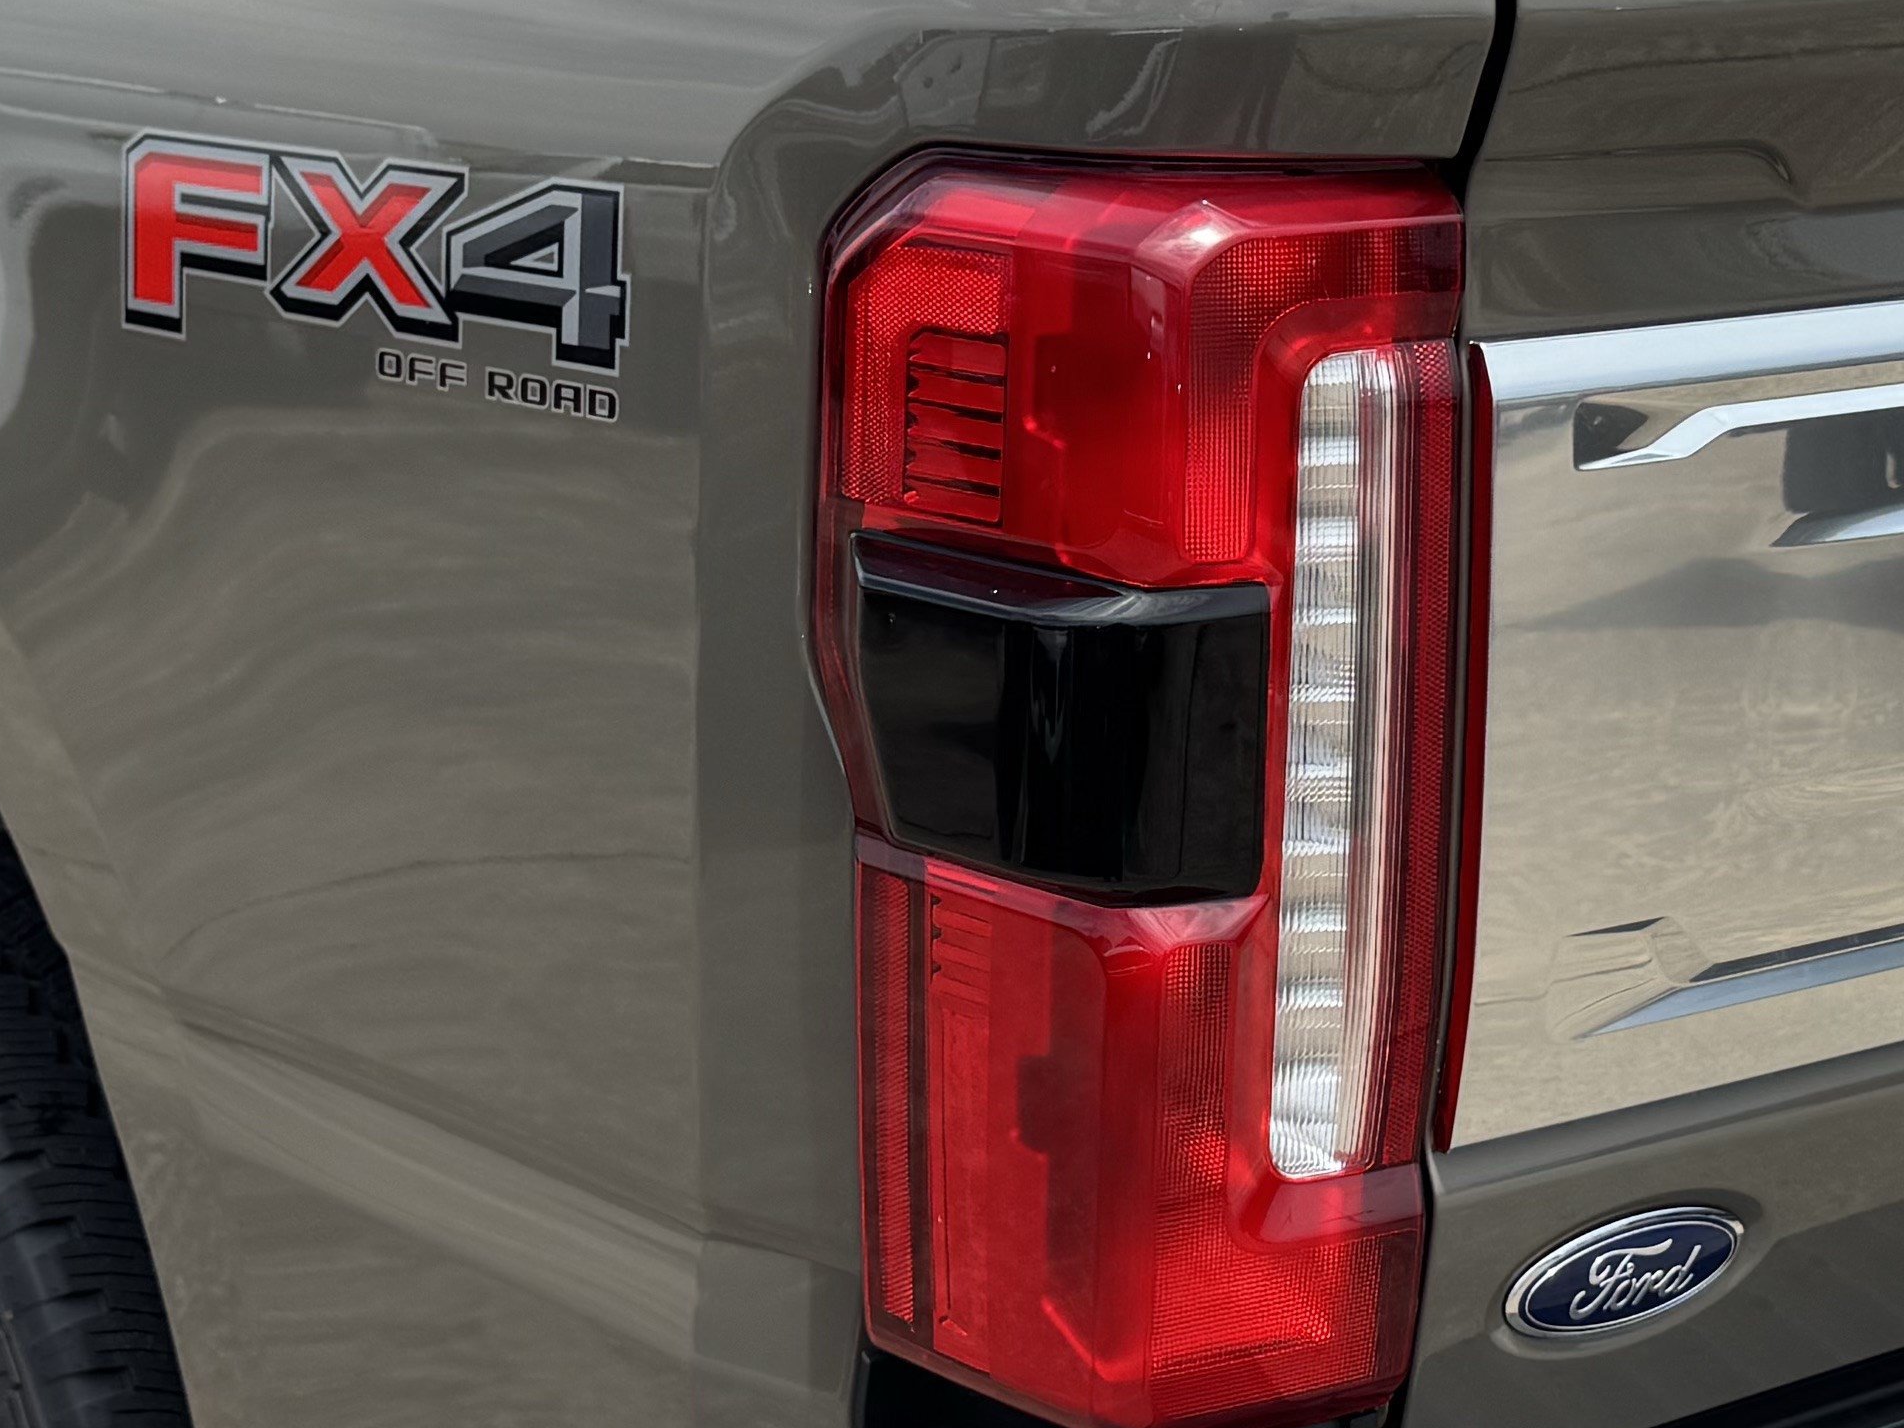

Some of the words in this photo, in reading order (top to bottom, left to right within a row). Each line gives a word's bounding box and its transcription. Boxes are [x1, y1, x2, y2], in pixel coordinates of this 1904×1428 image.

[122, 128, 631, 375] FX4
[376, 348, 467, 390] OFF
[485, 367, 620, 422] ROAD
[1568, 1238, 1702, 1320] Ford
